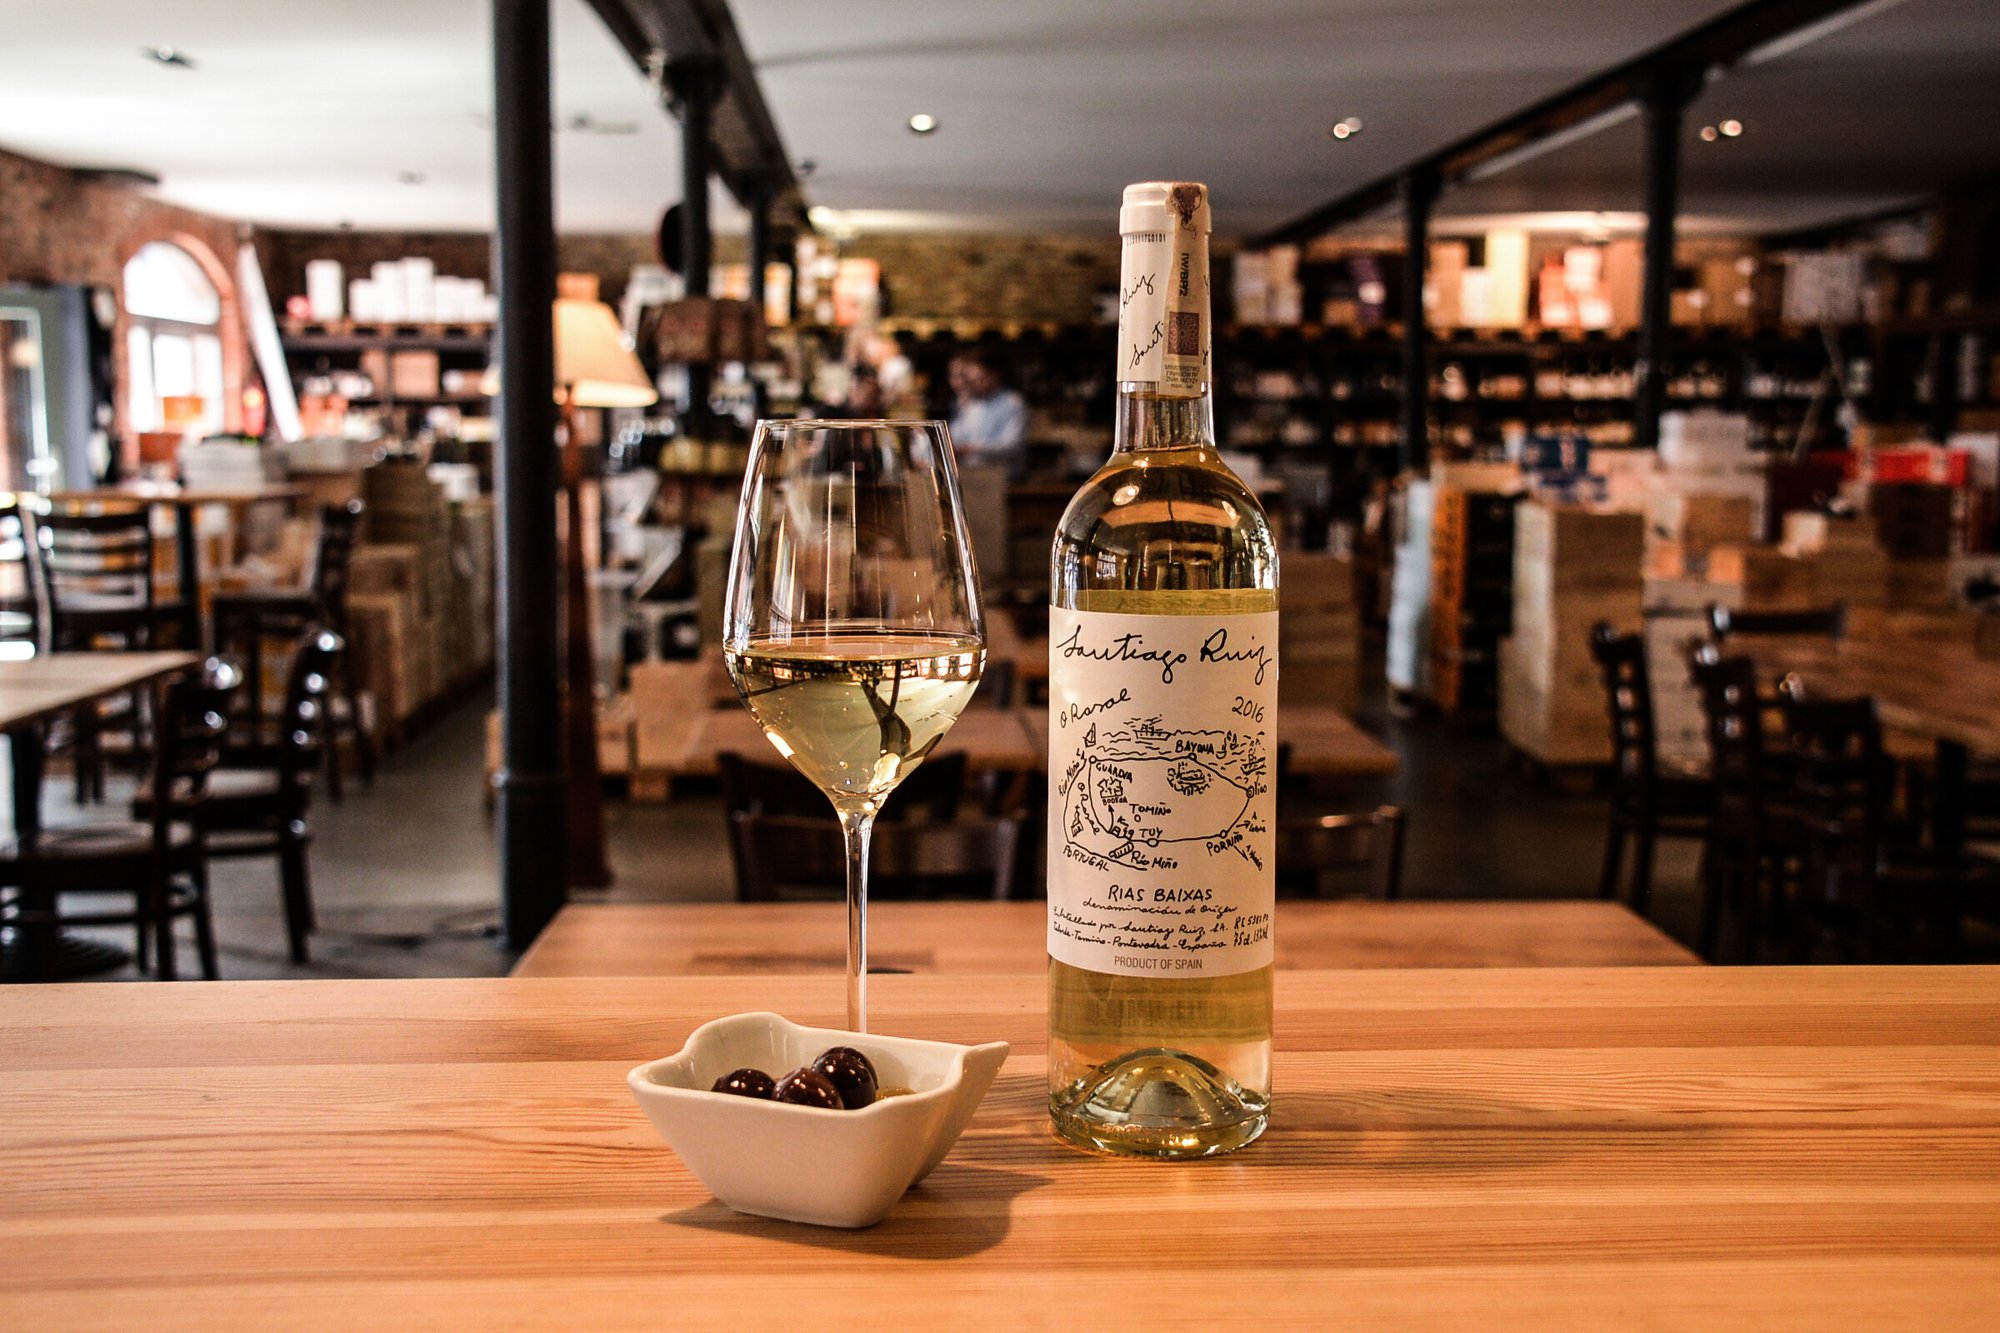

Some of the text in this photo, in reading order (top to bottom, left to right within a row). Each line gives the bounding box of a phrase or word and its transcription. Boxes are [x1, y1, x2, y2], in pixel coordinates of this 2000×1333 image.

[1056, 625, 1272, 685] Santiago Ruiz
[1070, 688, 1131, 720] Rosal
[1232, 696, 1264, 723] 2016
[1175, 740, 1214, 754] BAYONA
[1095, 762, 1133, 783] GUARDIA
[1139, 827, 1163, 838] TUY
[1206, 831, 1243, 856] PORRIÑO
[1063, 845, 1109, 871] PORTUGAL
[1108, 885, 1213, 902] RIAS BAIXAS
[1082, 897, 1182, 915] denominación
[1185, 904, 1196, 915] de
[1114, 955, 1203, 970] PRODUCT OF SPAIN
